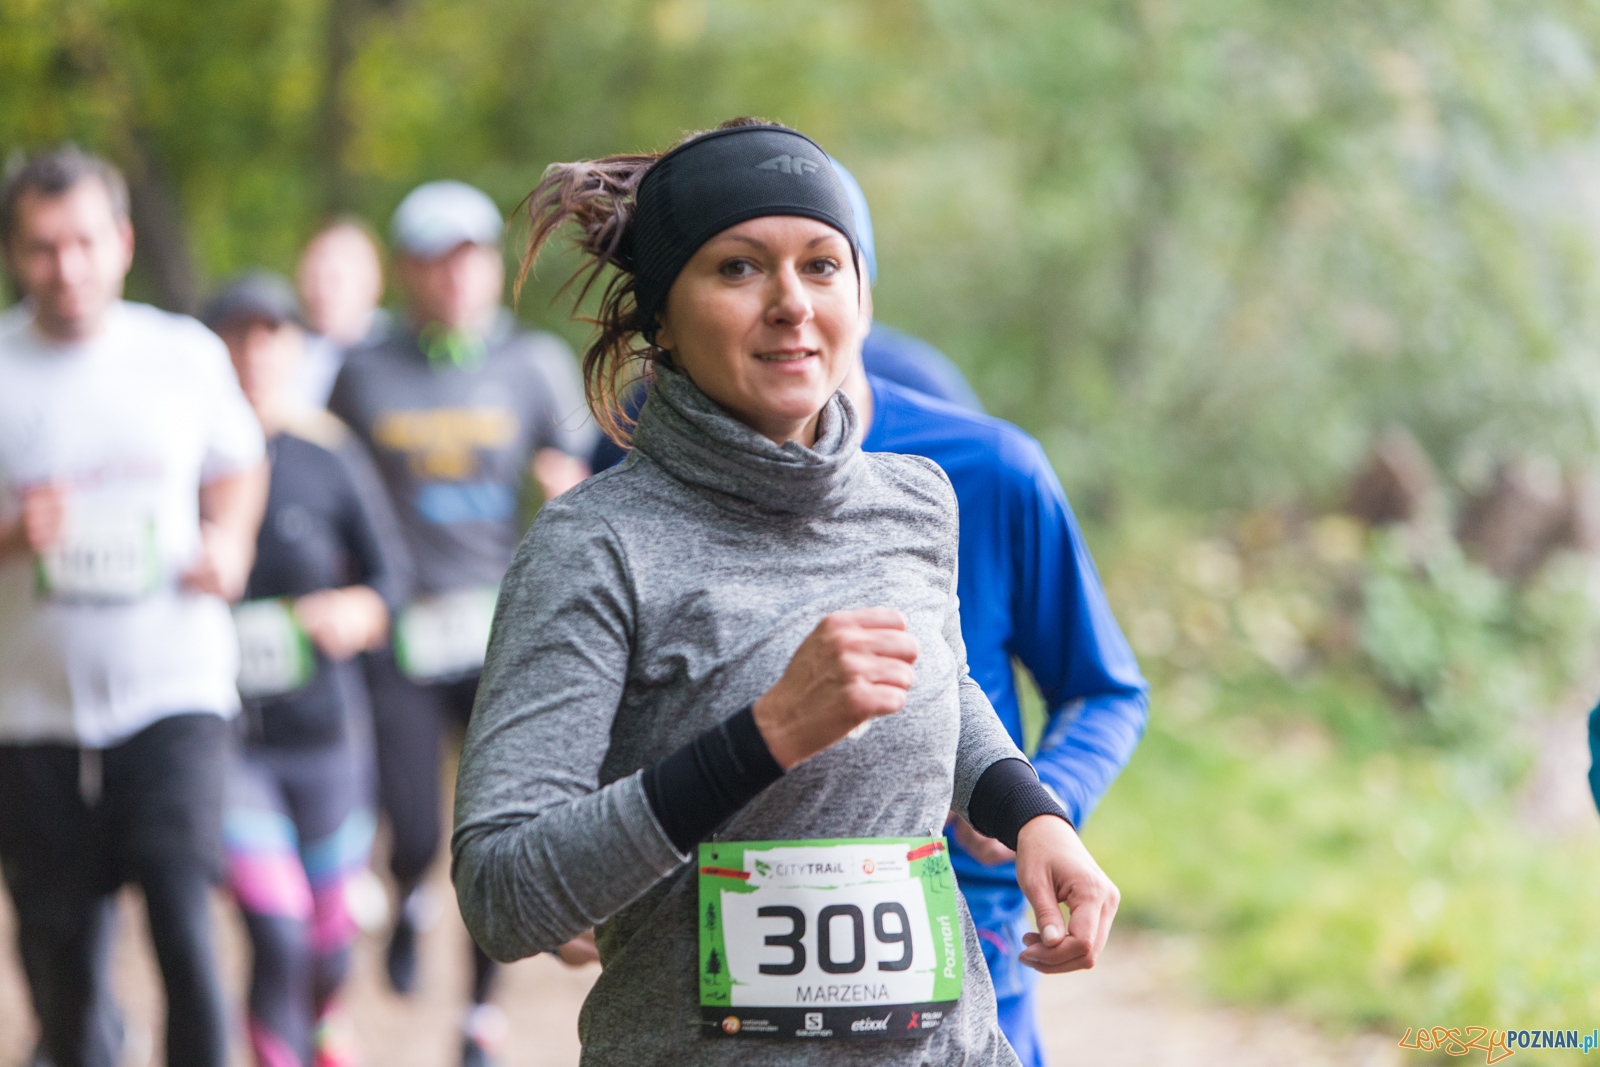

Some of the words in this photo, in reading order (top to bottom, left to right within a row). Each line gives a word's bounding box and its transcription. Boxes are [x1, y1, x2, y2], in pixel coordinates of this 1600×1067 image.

[757, 901, 914, 976] 309
[936, 915, 957, 979] Poznań
[796, 984, 890, 1003] MARZENA
